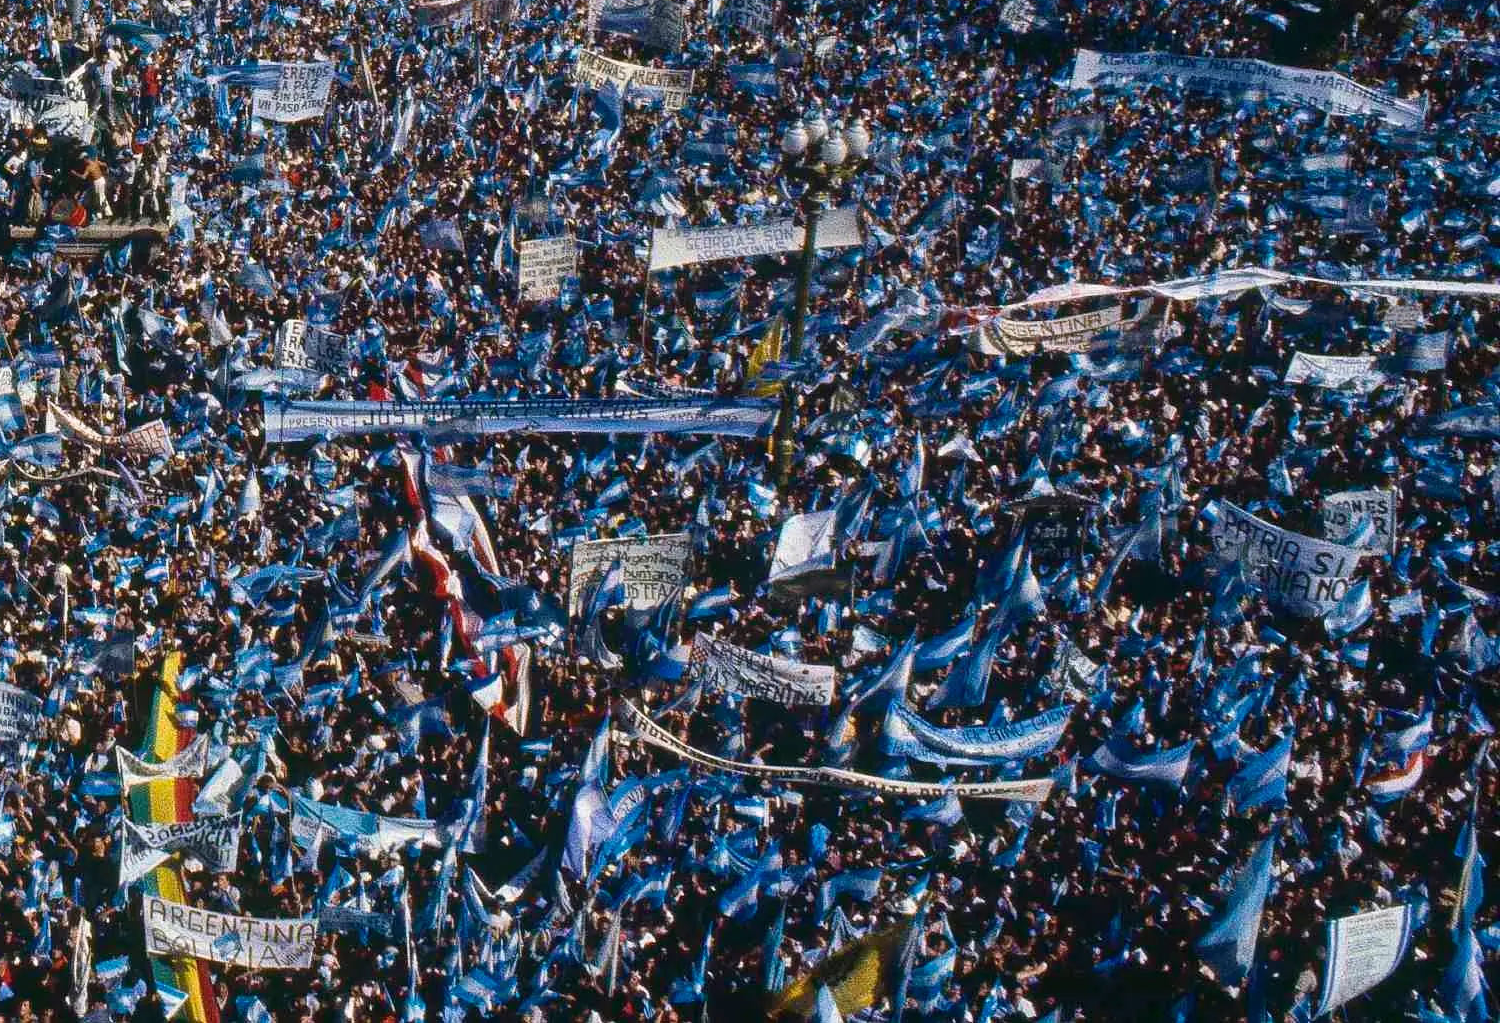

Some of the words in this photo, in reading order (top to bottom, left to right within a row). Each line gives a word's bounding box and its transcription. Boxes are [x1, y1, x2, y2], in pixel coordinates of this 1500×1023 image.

[1208, 57, 1287, 81] NACIONAL
[294, 78, 320, 90] PAZ
[275, 102, 300, 114] PASO
[684, 228, 757, 251] GEORGIAS
[762, 223, 794, 242] SON
[1223, 509, 1301, 562] PATRIA
[1308, 551, 1346, 578] SI
[1316, 578, 1349, 602] NO
[149, 898, 317, 946] ARGENTINA
[151, 927, 282, 969] BOLIIA
